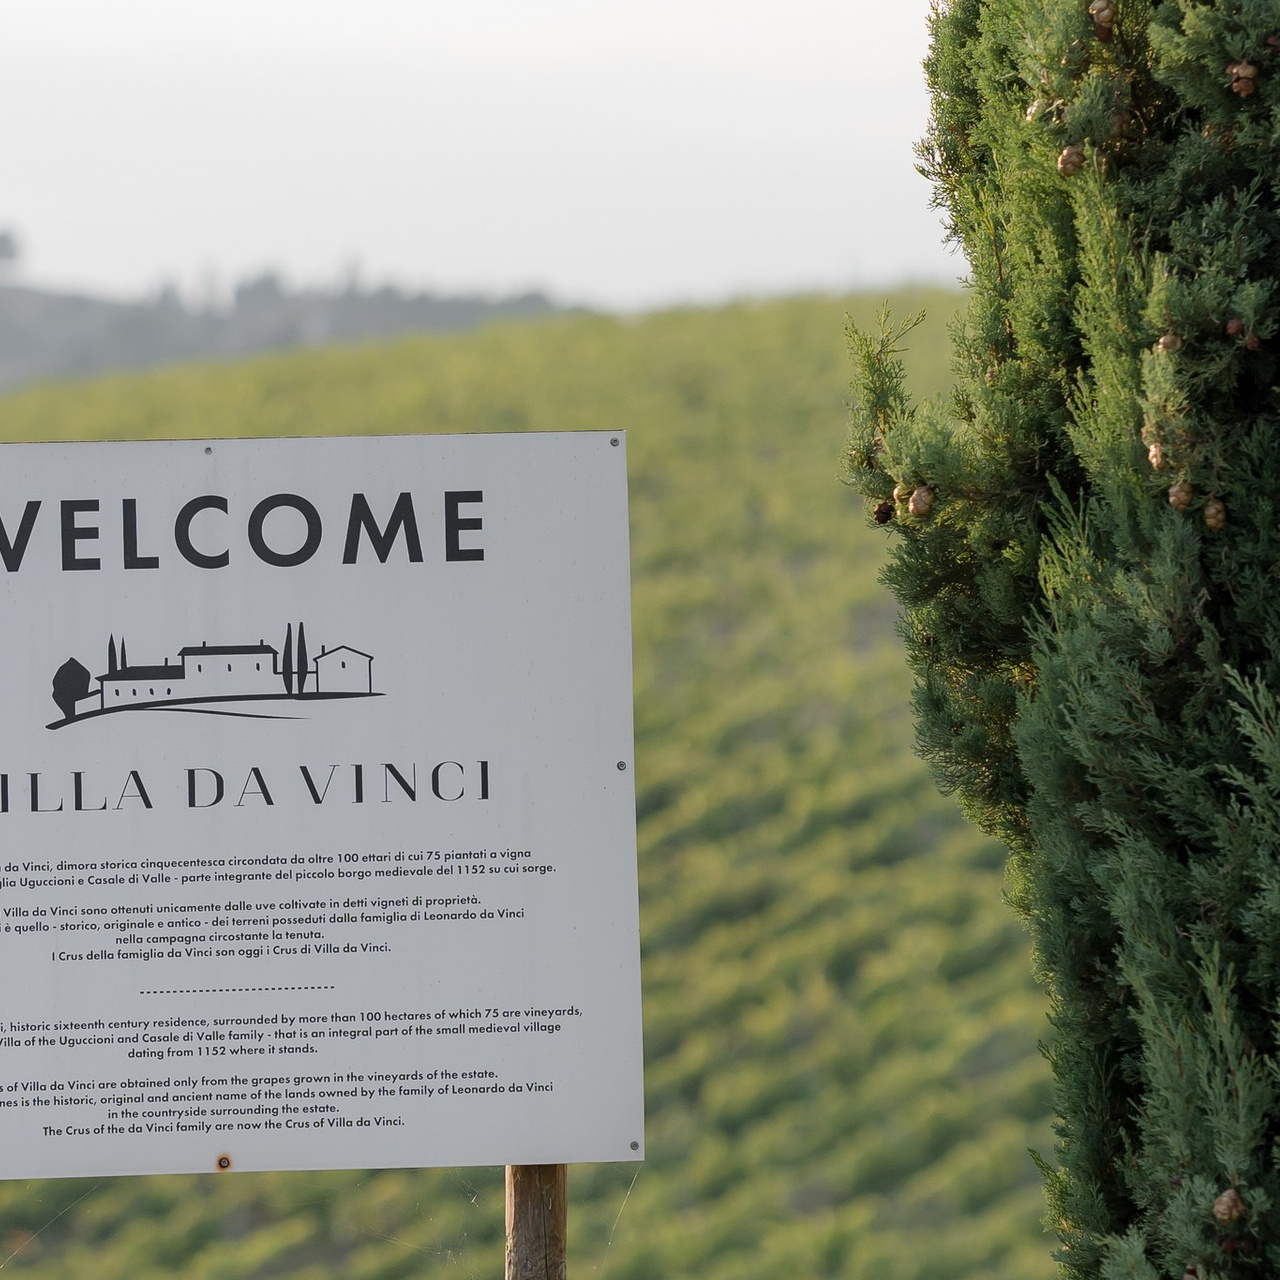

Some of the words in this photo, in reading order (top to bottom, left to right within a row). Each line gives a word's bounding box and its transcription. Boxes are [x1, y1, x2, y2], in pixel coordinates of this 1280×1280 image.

[186, 765, 276, 808] DA
[299, 760, 491, 805] VINCI
[4, 862, 19, 872] da
[22, 861, 53, 873] Vinci,
[56, 860, 97, 871] dimora
[100, 859, 137, 870] storica
[140, 858, 225, 871] cinquecentesca
[228, 855, 287, 866] circondata
[290, 854, 305, 864] da
[308, 853, 334, 864] oltre
[338, 853, 359, 863] 100
[362, 852, 391, 863] ettari
[394, 851, 405, 862] di
[408, 851, 423, 861] cui
[426, 851, 441, 861] 75
[444, 849, 487, 863] piantati
[499, 848, 531, 861] vigna
[3, 907, 29, 917] Villa
[32, 906, 47, 917] da
[50, 905, 77, 916] Vinci
[110, 903, 153, 915] ottenuti
[156, 903, 221, 913] unicamente
[224, 900, 252, 911] dalle
[279, 899, 326, 910] coltivate
[329, 898, 340, 908] in
[342, 897, 367, 908] detti
[370, 896, 409, 910] vigneti
[412, 896, 422, 906] di
[425, 894, 481, 908] proprietà.
[116, 934, 143, 944] nella
[146, 935, 206, 946] campagna
[209, 931, 269, 942] circostante
[272, 930, 282, 940] la
[285, 930, 324, 940] tenuta.
[58, 951, 83, 961] Crus
[86, 950, 114, 960] della
[117, 948, 164, 961] famiglia
[167, 947, 182, 958] da
[185, 947, 212, 957] Vinci
[215, 949, 235, 957] son
[238, 945, 263, 959] oggi
[273, 945, 298, 955] Crus
[300, 944, 311, 954] di
[314, 943, 340, 954] Villa
[343, 942, 357, 953] da
[360, 942, 391, 952] Vinci.
[10, 1021, 51, 1032] historic
[54, 1019, 105, 1031] sixteenth
[108, 1020, 150, 1031] century
[153, 1017, 210, 1028] residence,
[213, 1014, 278, 1026] surrounded
[281, 1013, 296, 1027] by
[330, 1012, 356, 1022] than
[360, 1011, 381, 1022] 100
[384, 1011, 431, 1021] hectares
[434, 1009, 446, 1020] of
[448, 1008, 482, 1019] which
[485, 1008, 499, 1018] 75
[502, 1010, 521, 1018] are
[524, 1005, 583, 1019] vineyards,
[128, 1048, 164, 1060] dating
[167, 1047, 194, 1057] from
[198, 1046, 226, 1056] 1152
[229, 1045, 265, 1055] where
[268, 1044, 275, 1054] it
[278, 1043, 318, 1054] stands.
[6, 1081, 18, 1092] of
[21, 1081, 47, 1092] Villa
[50, 1080, 64, 1091] da
[67, 1079, 95, 1090] Vinci
[120, 1077, 170, 1089] obtained
[173, 1076, 198, 1089] only
[201, 1076, 228, 1086] from
[230, 1075, 248, 1085] the
[251, 1077, 290, 1087] grapes
[293, 1076, 330, 1086] grown
[333, 1072, 344, 1082] in
[346, 1072, 364, 1082] the
[367, 1070, 424, 1084] vineyards
[426, 1069, 438, 1080] of
[440, 1069, 458, 1080] the
[461, 1070, 498, 1079] estate.
[21, 1097, 30, 1107] is
[32, 1096, 50, 1106] the
[53, 1095, 97, 1106] historic,
[100, 1093, 144, 1106] original
[147, 1092, 169, 1103] and
[172, 1091, 213, 1102] ancient
[216, 1093, 247, 1101] name
[250, 1089, 262, 1100] of
[264, 1089, 282, 1099] the
[285, 1088, 316, 1099] lands
[318, 1087, 357, 1098] owned
[361, 1086, 375, 1099] by
[378, 1086, 396, 1096] the
[399, 1085, 435, 1098] family
[437, 1084, 449, 1095] of
[452, 1083, 505, 1094] Leonardo
[508, 1082, 523, 1093] da
[525, 1081, 553, 1092] Vinci
[108, 1109, 118, 1119] in
[121, 1108, 139, 1118] the
[141, 1106, 207, 1120] countryside
[210, 1104, 279, 1117] surrounding
[281, 1103, 299, 1114] the
[302, 1104, 339, 1114] estate.
[42, 1126, 63, 1136] The
[65, 1126, 90, 1135] Crus
[93, 1124, 105, 1135] of
[107, 1124, 125, 1134] the
[128, 1123, 143, 1133] da
[145, 1122, 173, 1133] Vinci
[176, 1121, 212, 1134] family
[215, 1123, 234, 1131] are
[264, 1119, 282, 1129] the
[285, 1119, 310, 1129] Crus
[313, 1117, 325, 1128] of
[327, 1117, 353, 1128] Villa
[356, 1116, 371, 1127] da
[373, 1116, 405, 1126] Vinci.
